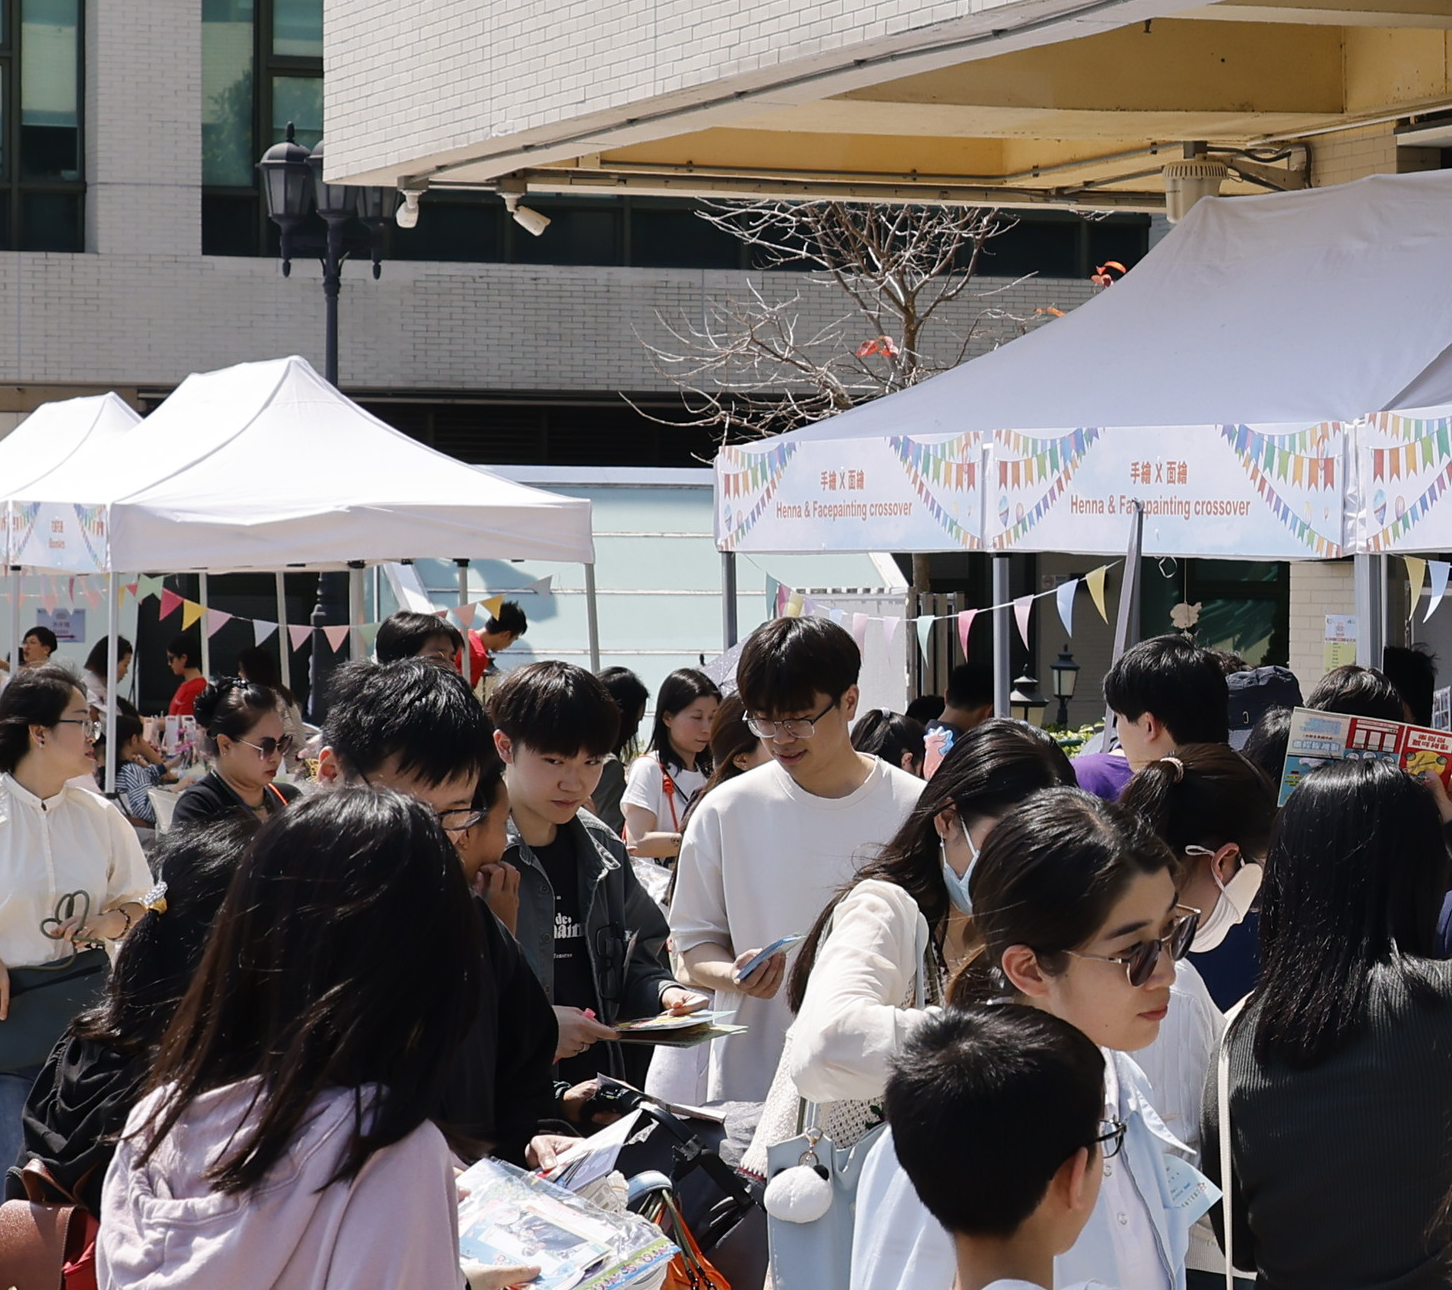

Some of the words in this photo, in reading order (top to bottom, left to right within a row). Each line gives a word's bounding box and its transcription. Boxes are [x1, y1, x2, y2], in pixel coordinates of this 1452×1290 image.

[820, 470, 837, 491] 手繪
[848, 469, 865, 490] 面繪
[1130, 461, 1152, 485] 手繪
[1166, 460, 1188, 485] 面繪
[776, 501, 802, 519] Henna
[804, 500, 811, 518] &
[813, 500, 867, 521] Facepainting
[869, 502, 913, 517] crossover
[1070, 494, 1105, 514] Henna
[1108, 494, 1116, 514] &
[1119, 494, 1191, 520] Fapainting
[1194, 499, 1251, 516] crossover
